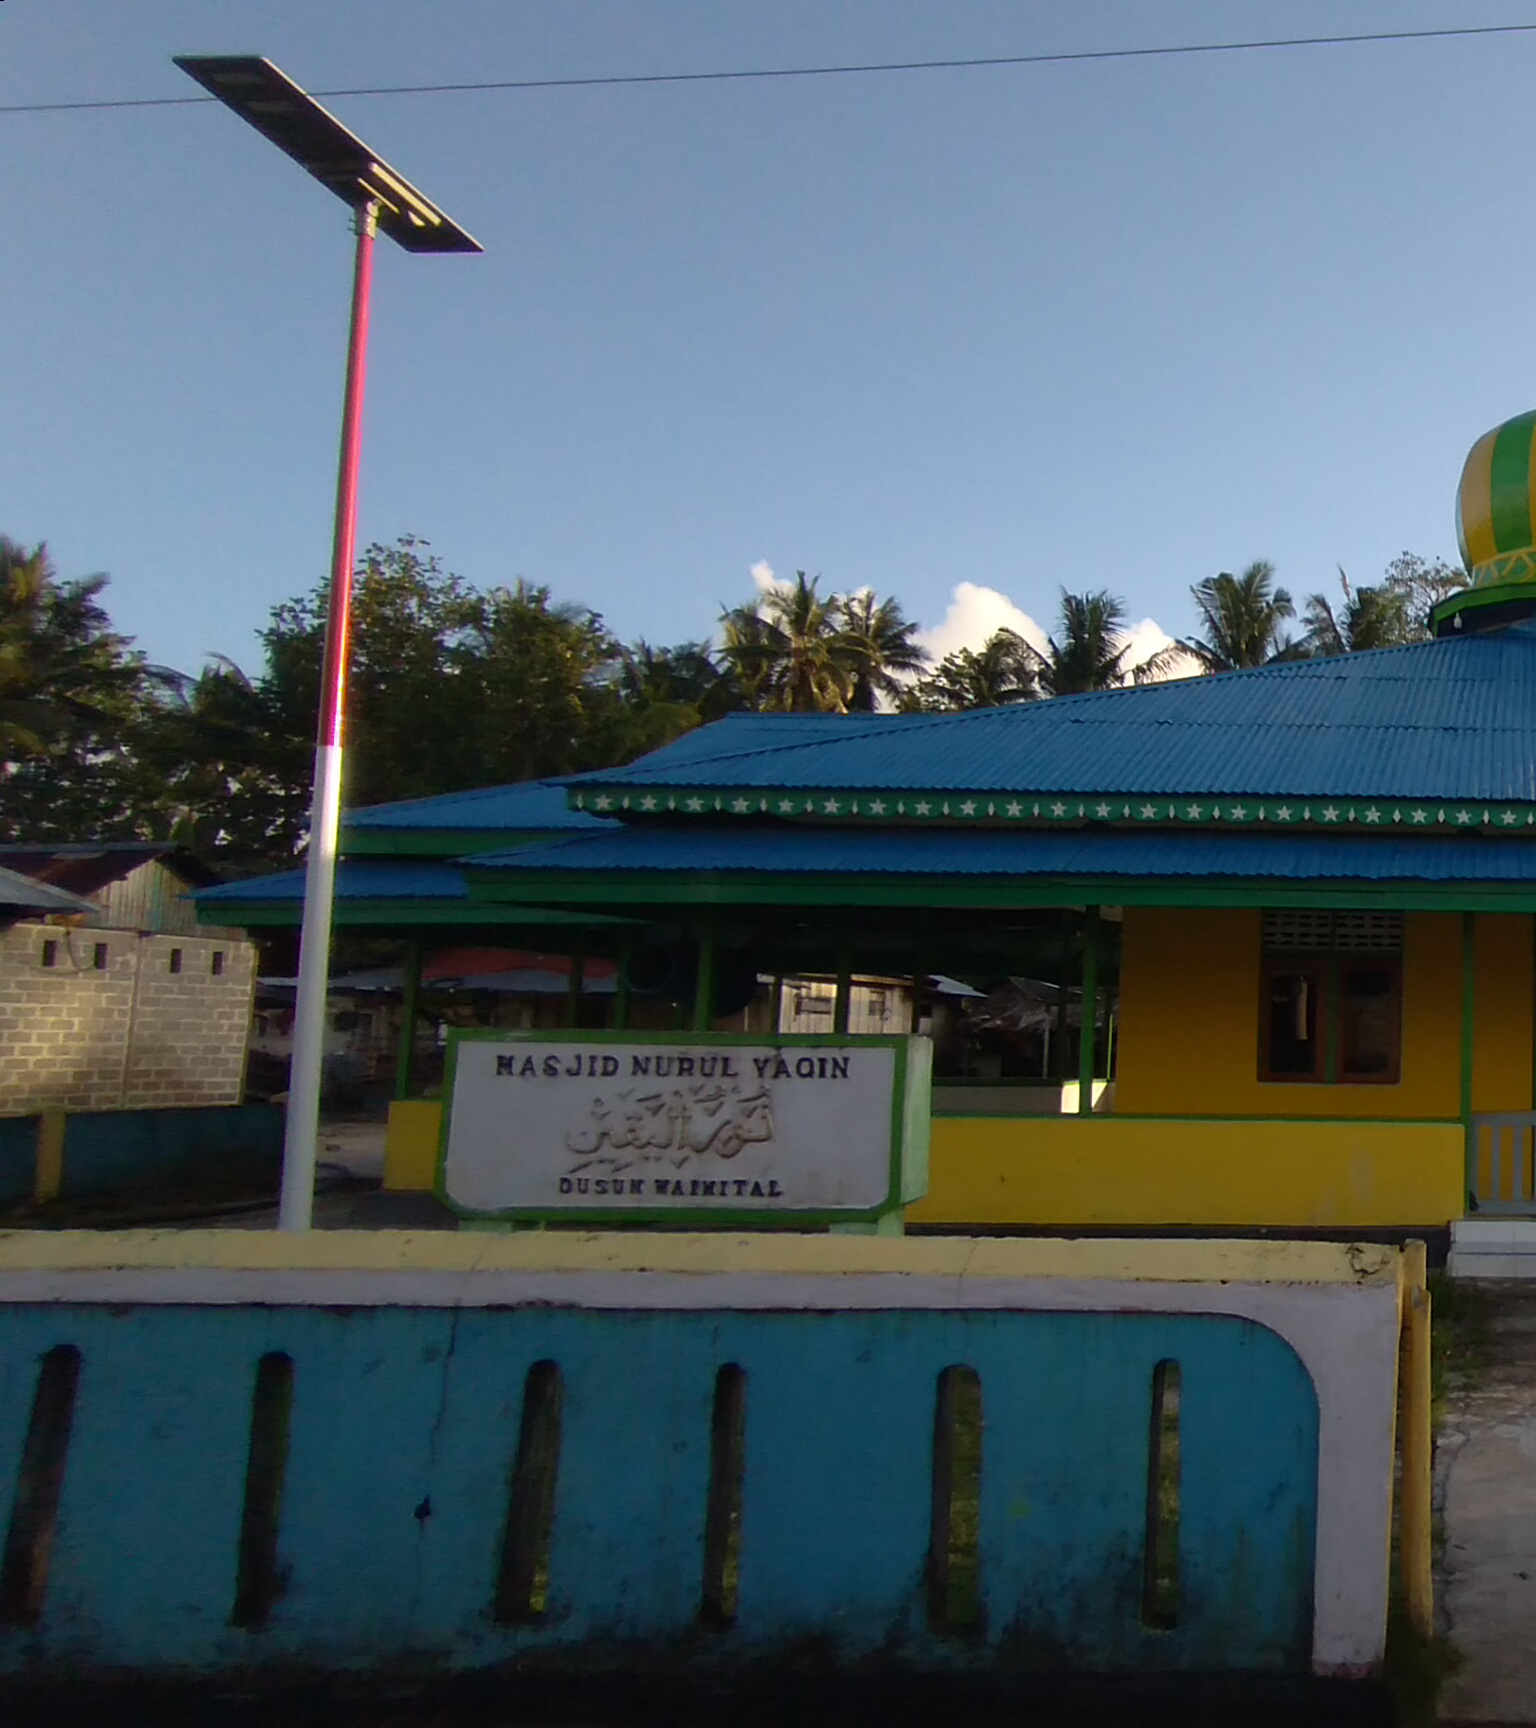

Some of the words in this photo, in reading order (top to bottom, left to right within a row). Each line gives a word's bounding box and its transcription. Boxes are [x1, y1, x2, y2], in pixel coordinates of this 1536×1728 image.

[495, 1054, 619, 1078] MASJID
[630, 1055, 738, 1078] NURUL
[752, 1056, 850, 1079] YAQIN
[559, 1177, 644, 1195] DUSUN
[654, 1179, 783, 1197] WAIMITAL
